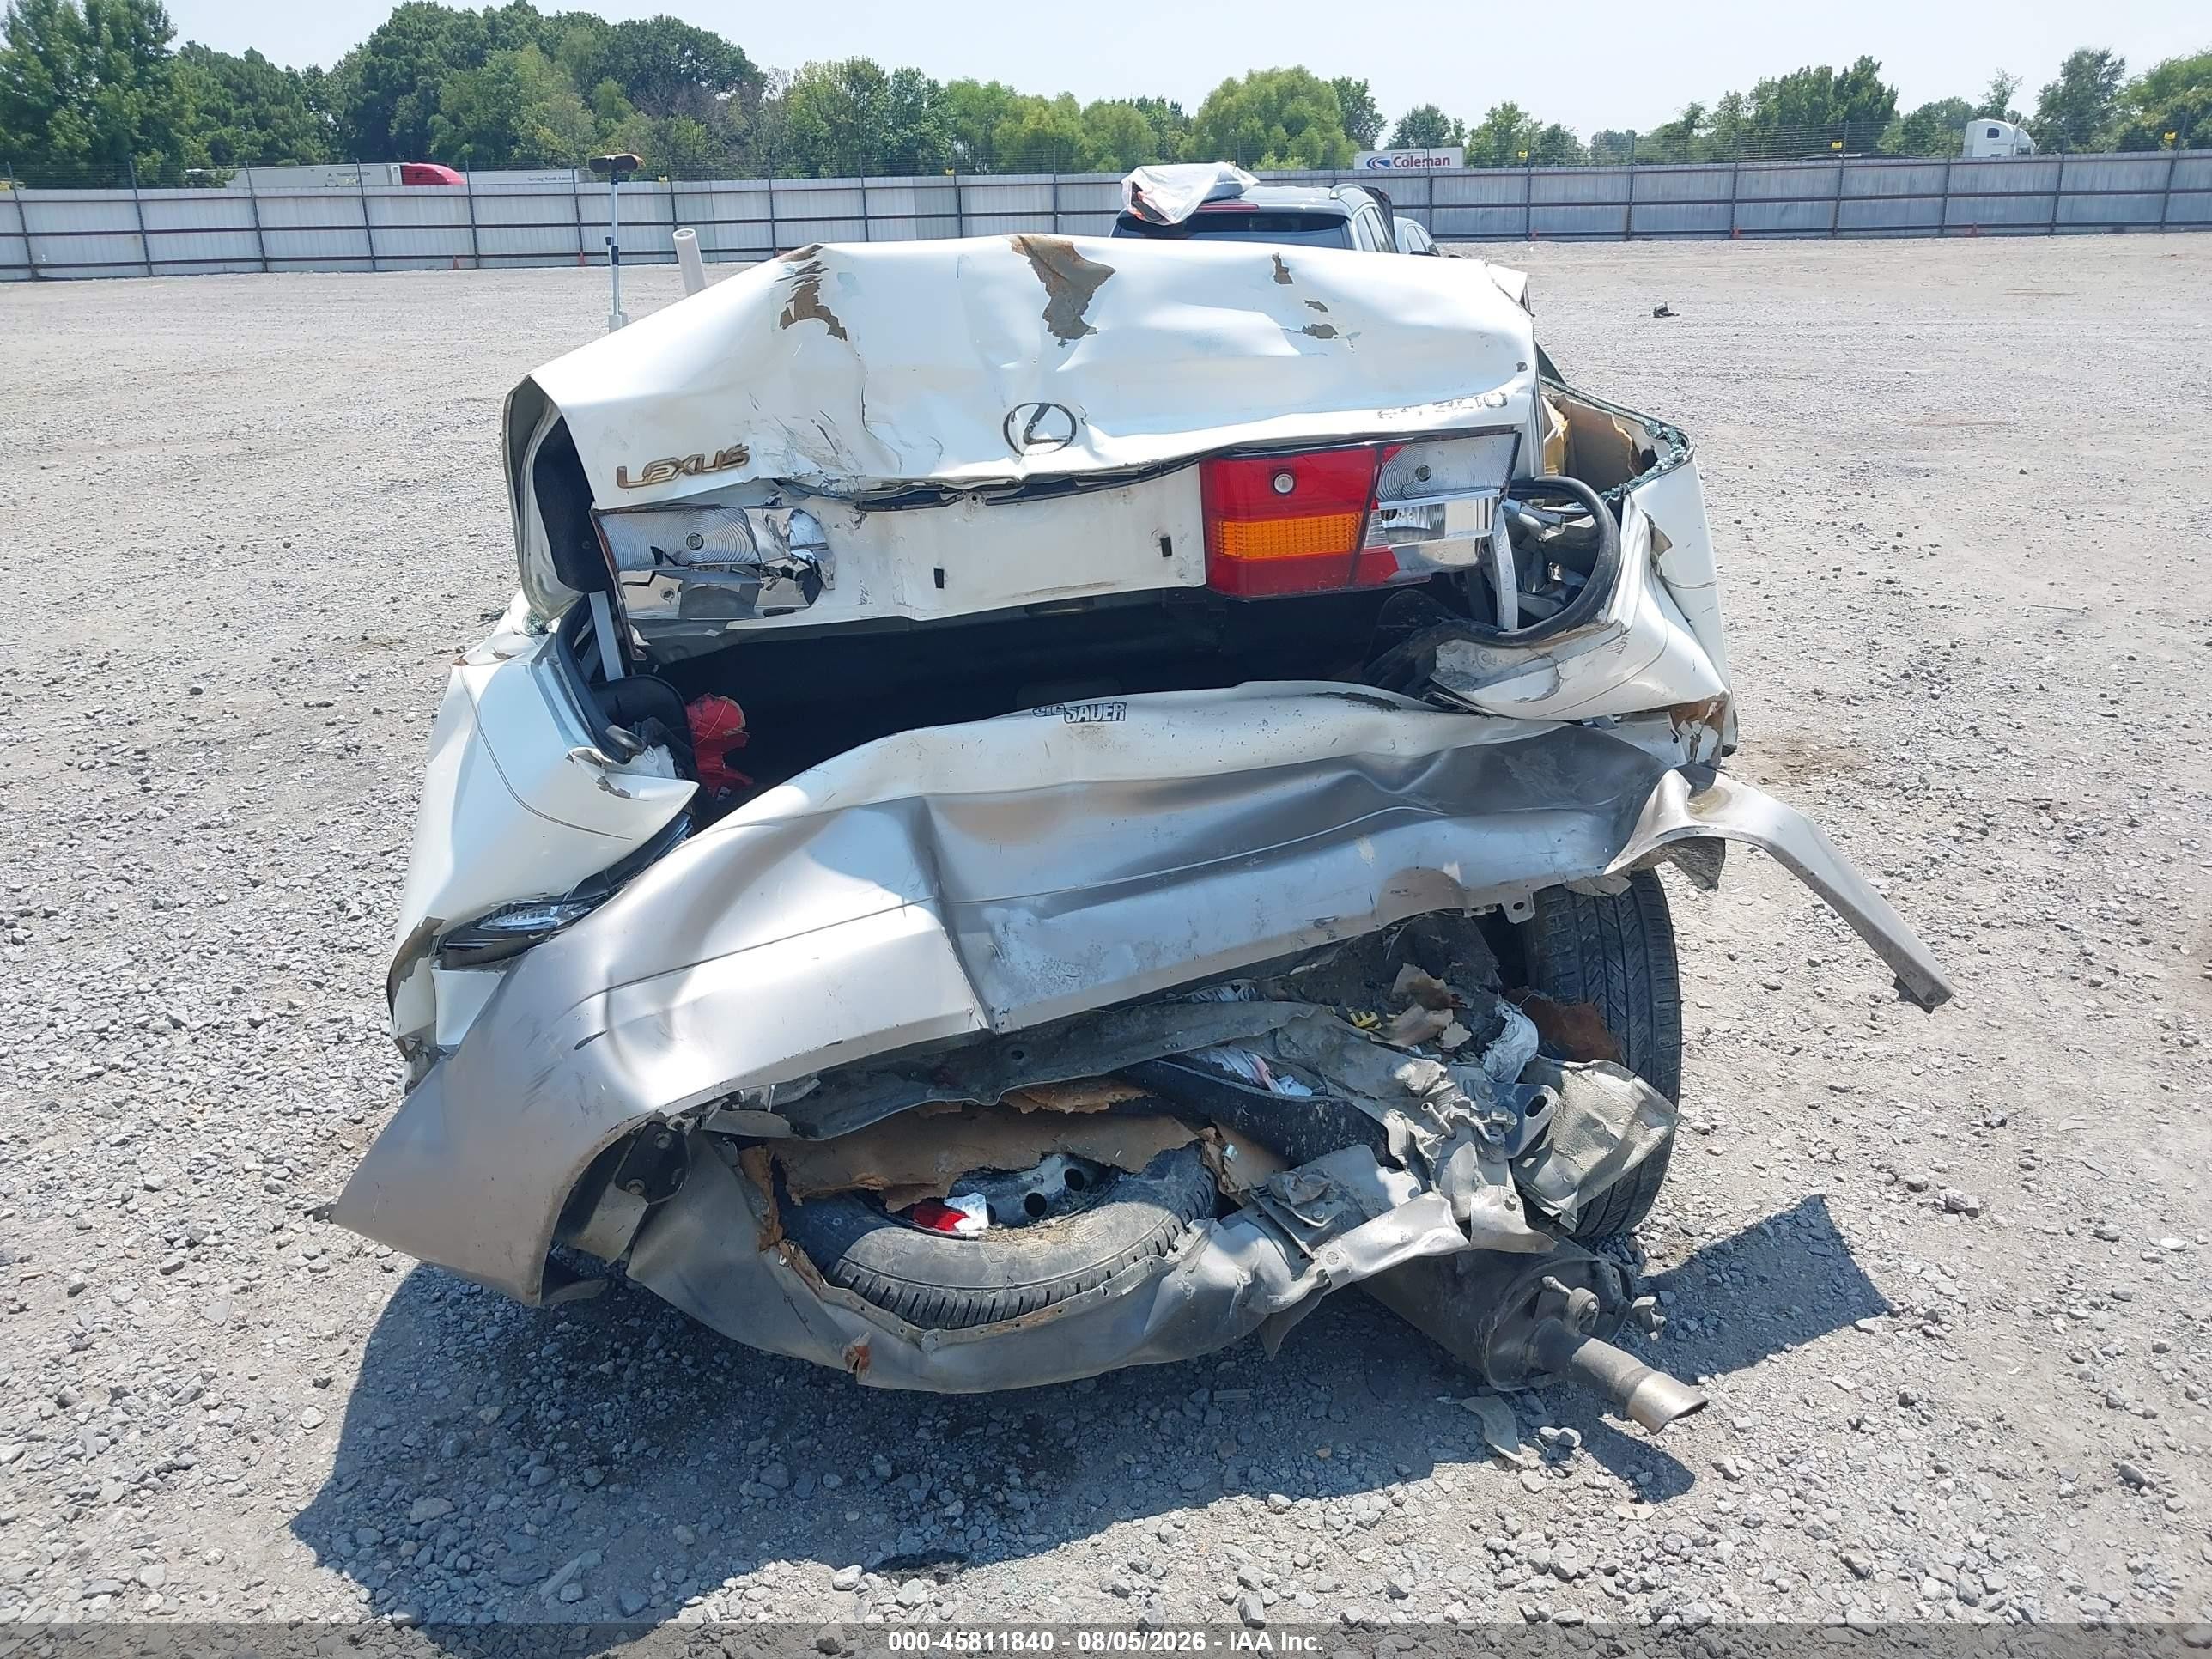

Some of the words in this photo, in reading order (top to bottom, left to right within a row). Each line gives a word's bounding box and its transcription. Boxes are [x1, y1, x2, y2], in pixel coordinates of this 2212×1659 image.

[1393, 155, 1451, 168] Coleman
[616, 442, 750, 489] LEXUS
[1032, 704, 1066, 717] SIG
[1065, 702, 1127, 724] SAUER
